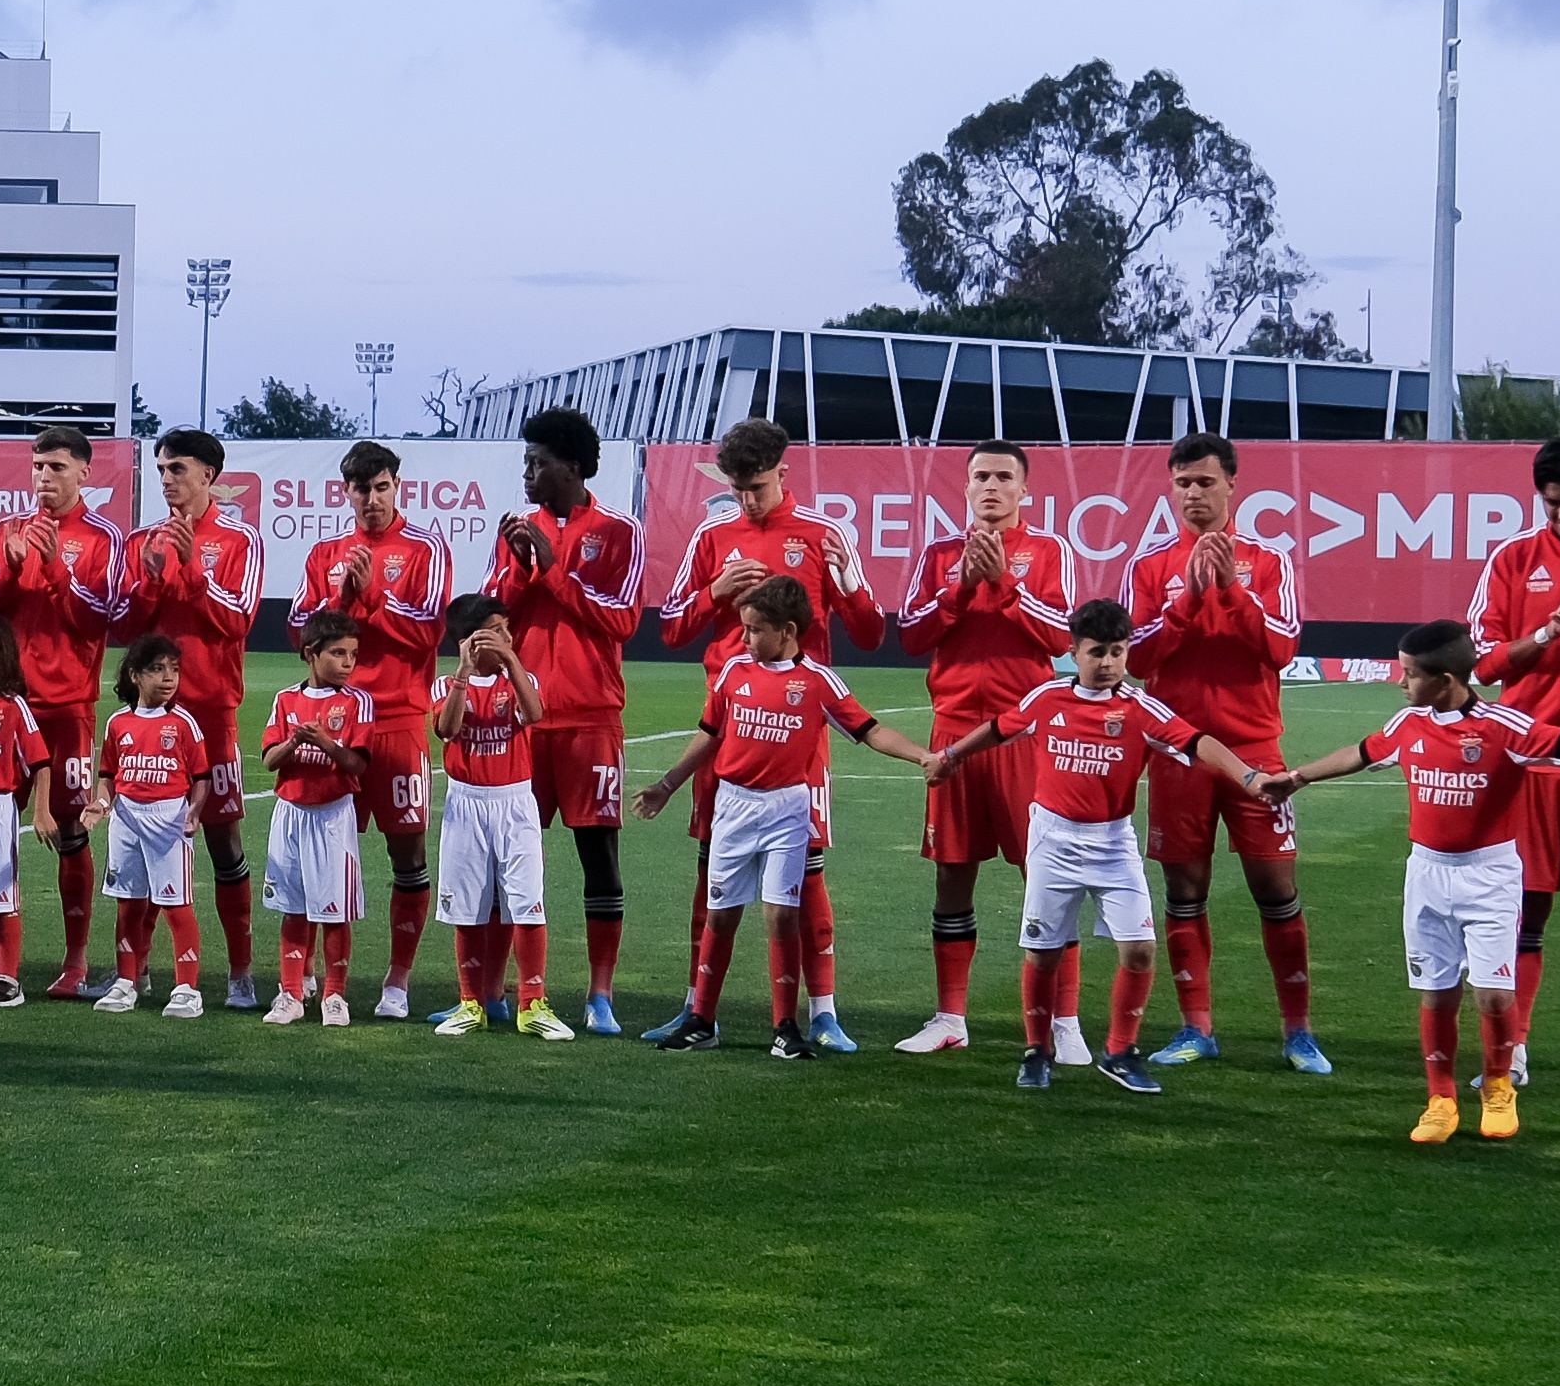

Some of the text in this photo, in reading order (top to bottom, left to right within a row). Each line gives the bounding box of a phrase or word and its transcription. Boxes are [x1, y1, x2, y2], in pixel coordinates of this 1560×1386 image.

[272, 479, 486, 510] SL BFICA
[814, 493, 1179, 562] BENICA
[733, 703, 803, 730] Emirates
[753, 726, 790, 744] BETTER
[1047, 734, 1124, 761] Emirates
[65, 756, 93, 790] 85
[119, 752, 178, 771] Emirates
[1071, 758, 1110, 776] BETTER
[135, 770, 169, 784] BETTER
[592, 765, 620, 801] 72
[1410, 764, 1489, 789] Emirates
[392, 773, 423, 809] 60
[1432, 789, 1475, 807] BETTER
